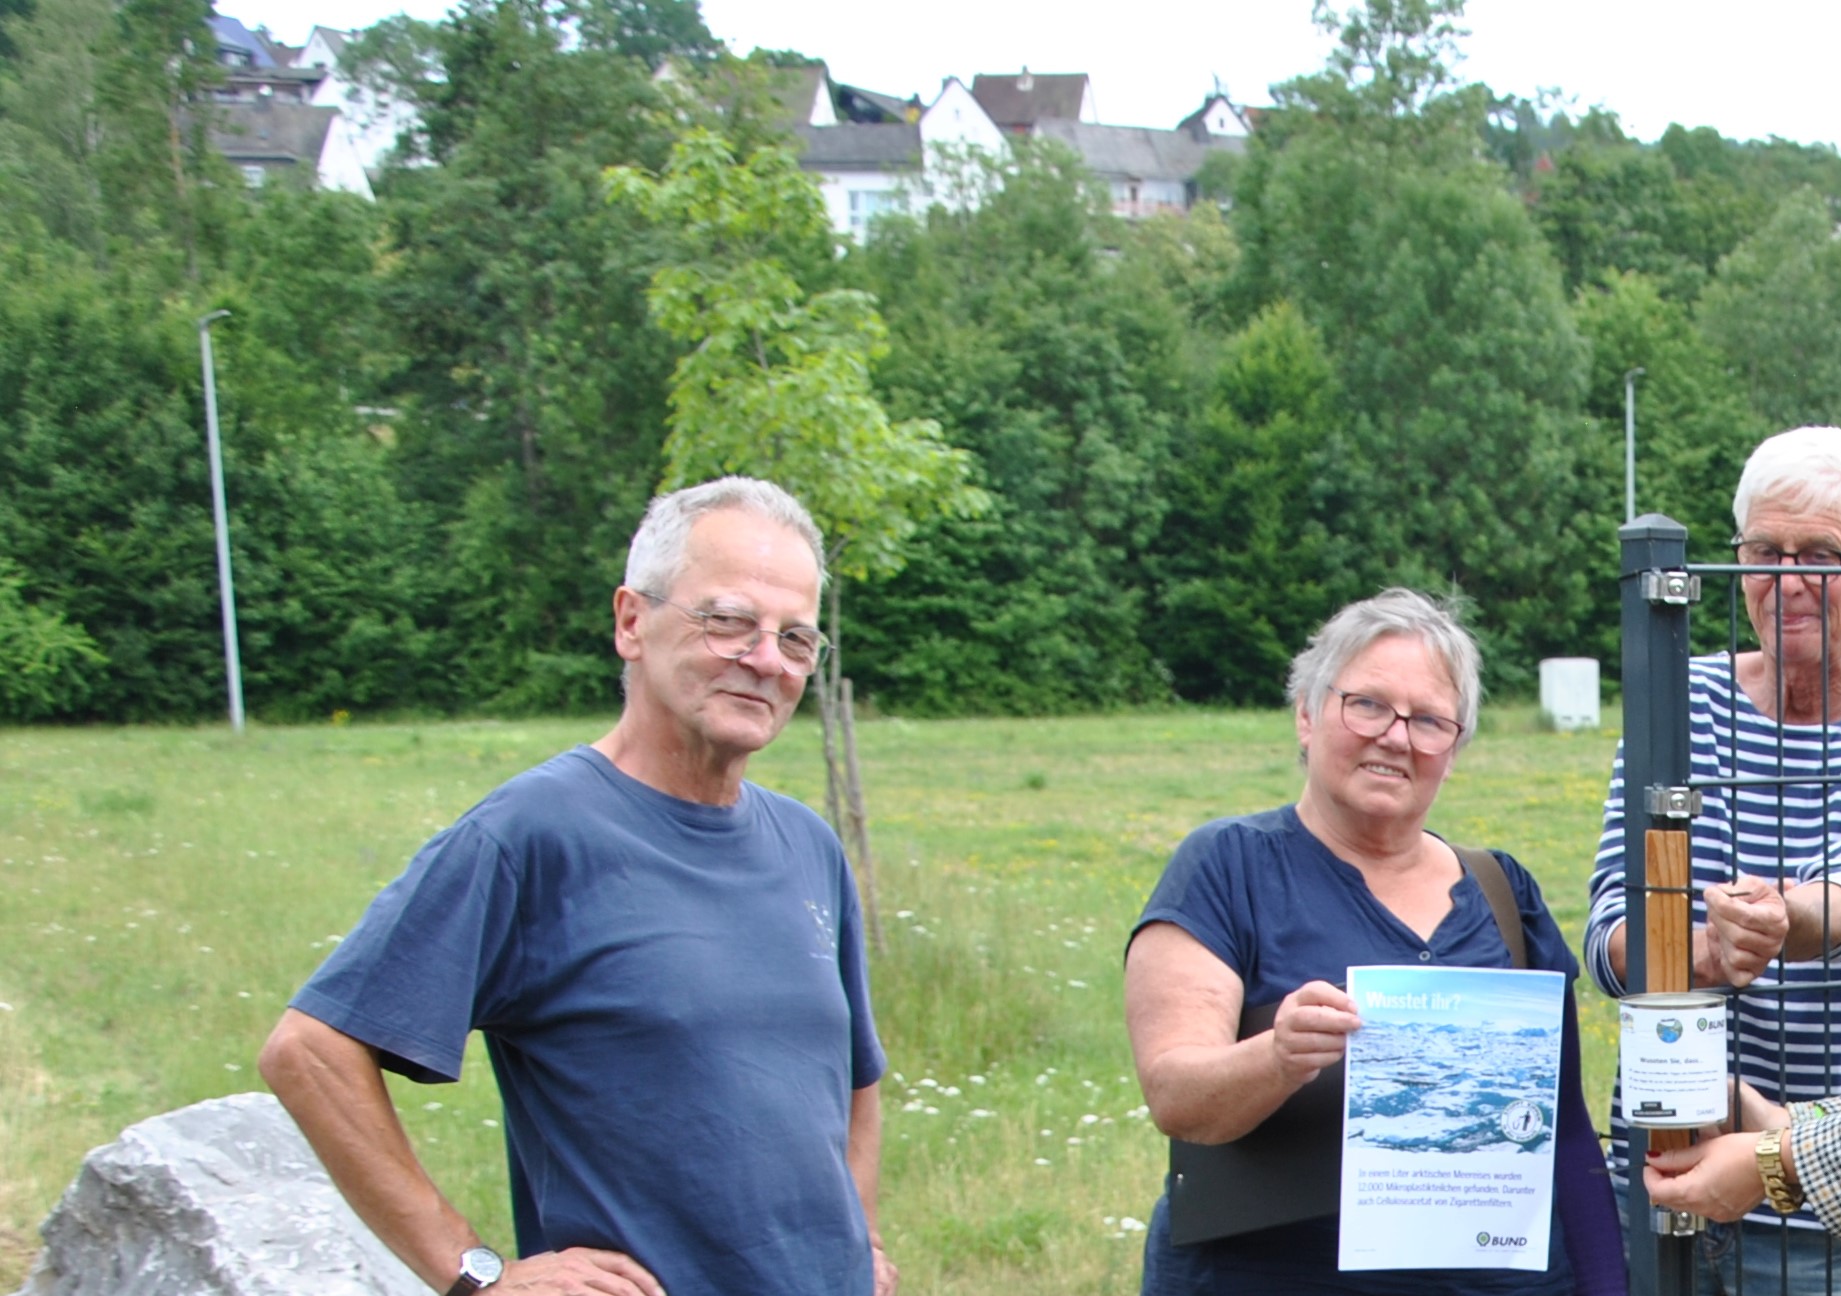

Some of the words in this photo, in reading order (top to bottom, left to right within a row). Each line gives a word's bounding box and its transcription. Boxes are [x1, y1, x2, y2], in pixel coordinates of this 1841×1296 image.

[1365, 991, 1428, 1009] Wusstet
[1431, 992, 1461, 1010] ihr?
[1368, 1170, 1391, 1178] einem
[1392, 1169, 1409, 1178] Liter
[1411, 1169, 1451, 1179] arktischen
[1453, 1170, 1491, 1180] Meereises
[1493, 1171, 1522, 1181] wurden
[1386, 1183, 1461, 1193] Mikroplastikteilchen
[1464, 1184, 1499, 1195] gefunden.
[1502, 1185, 1536, 1195] Darunter
[1357, 1196, 1374, 1206] auch
[1376, 1196, 1432, 1206] Celluloseacetat
[1434, 1198, 1448, 1206] von
[1449, 1197, 1512, 1208] Zigarettenfiltern.
[1492, 1237, 1528, 1246] BUND
